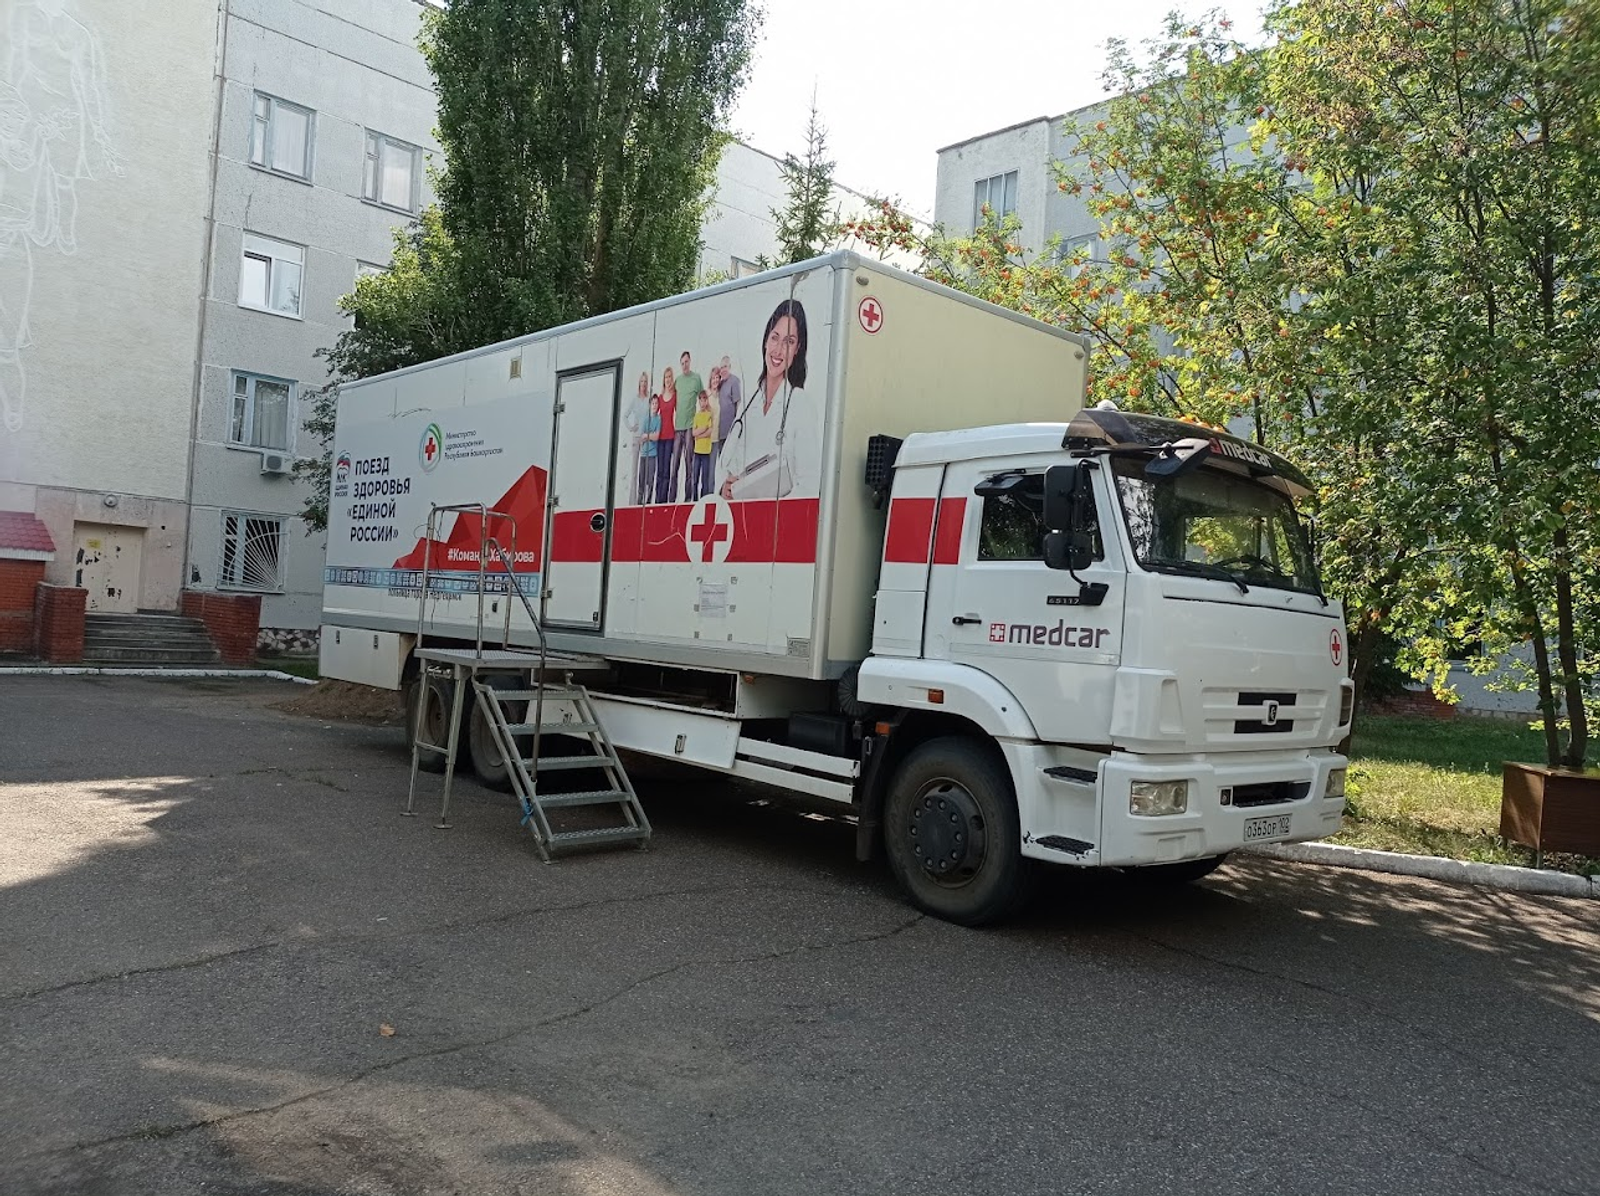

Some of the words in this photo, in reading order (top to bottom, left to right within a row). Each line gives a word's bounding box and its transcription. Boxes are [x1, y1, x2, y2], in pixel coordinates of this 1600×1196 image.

[1218, 439, 1272, 468] medcar
[355, 456, 390, 476] ПОЕЗД
[353, 477, 411, 500] ЗДОРОВЬЯ
[347, 498, 396, 522] «ЕДИНОЙ
[350, 525, 399, 542] РОССИИ»
[1048, 597, 1080, 605] 65117
[1009, 618, 1111, 648] medcar
